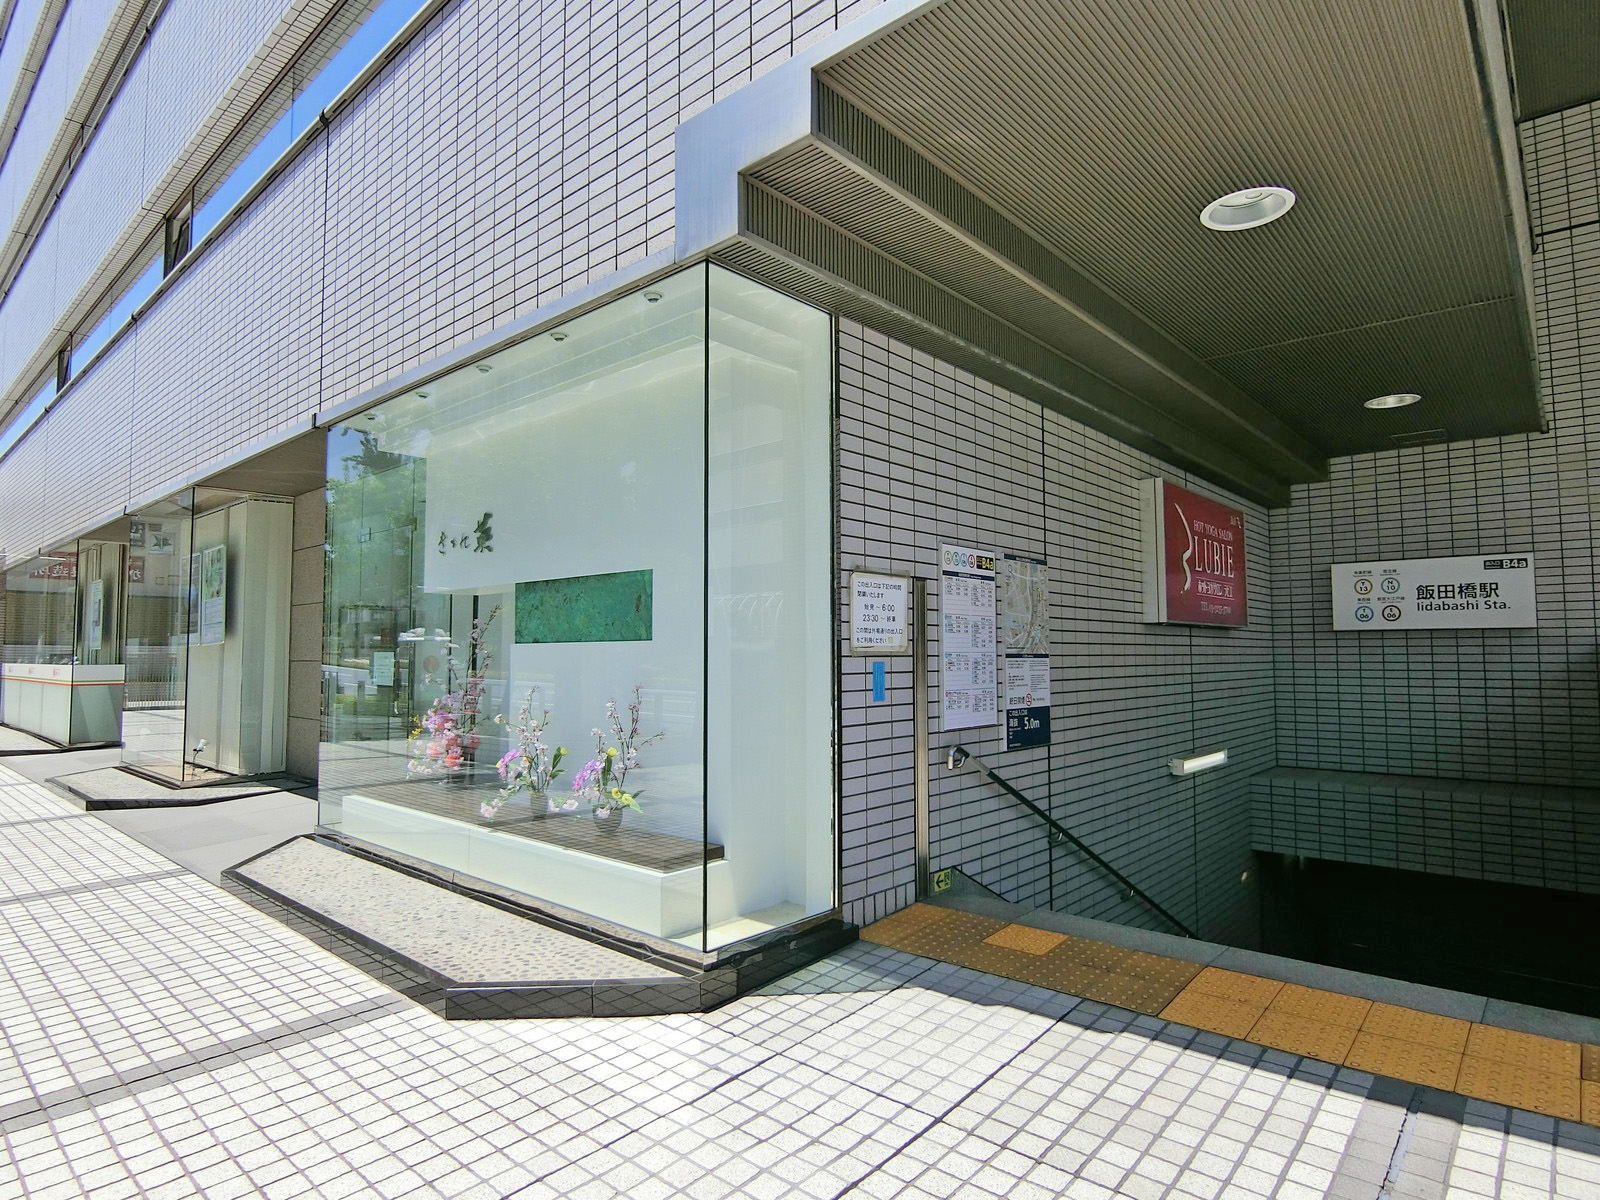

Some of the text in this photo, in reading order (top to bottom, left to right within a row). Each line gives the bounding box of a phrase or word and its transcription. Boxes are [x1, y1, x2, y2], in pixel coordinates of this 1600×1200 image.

[1193, 519, 1204, 534] HOT
[1205, 523, 1218, 538] YOGA
[1194, 535, 1235, 578] LUBIE
[981, 557, 994, 570] B4a
[1502, 559, 1527, 568] B4a
[1415, 582, 1500, 600] 飯田橋駅
[881, 603, 896, 612] 6:00
[1416, 599, 1511, 612] Iidabashi Sta.
[862, 613, 879, 622] 23:30
[1024, 716, 1041, 730] 5.0m
